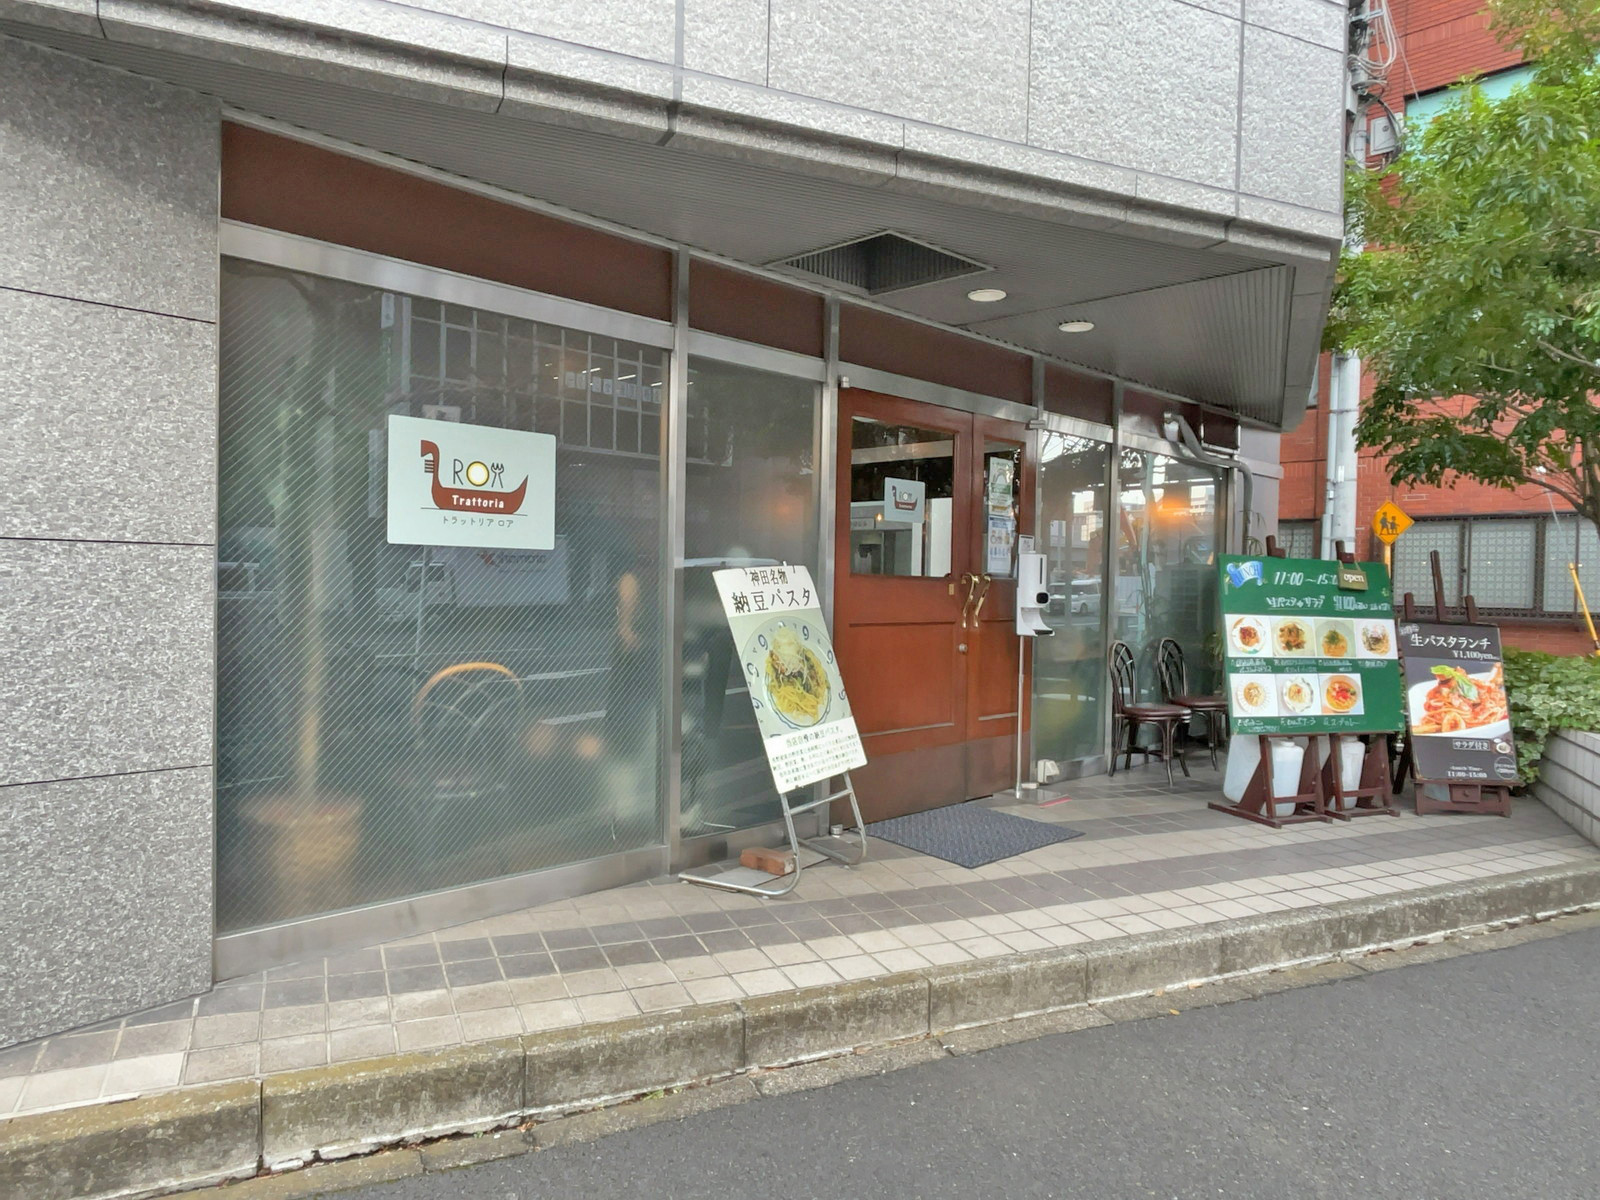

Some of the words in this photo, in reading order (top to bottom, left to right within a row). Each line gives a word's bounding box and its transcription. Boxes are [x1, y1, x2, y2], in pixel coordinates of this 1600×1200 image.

[452, 494, 505, 509] Trattoria
[443, 516, 494, 527] トラットリア
[498, 519, 514, 528] ロア
[750, 568, 789, 586] 神田名物
[1343, 573, 1365, 584] open
[732, 588, 811, 613] 納豆パスタ
[1410, 633, 1492, 650] 生パスタランチ
